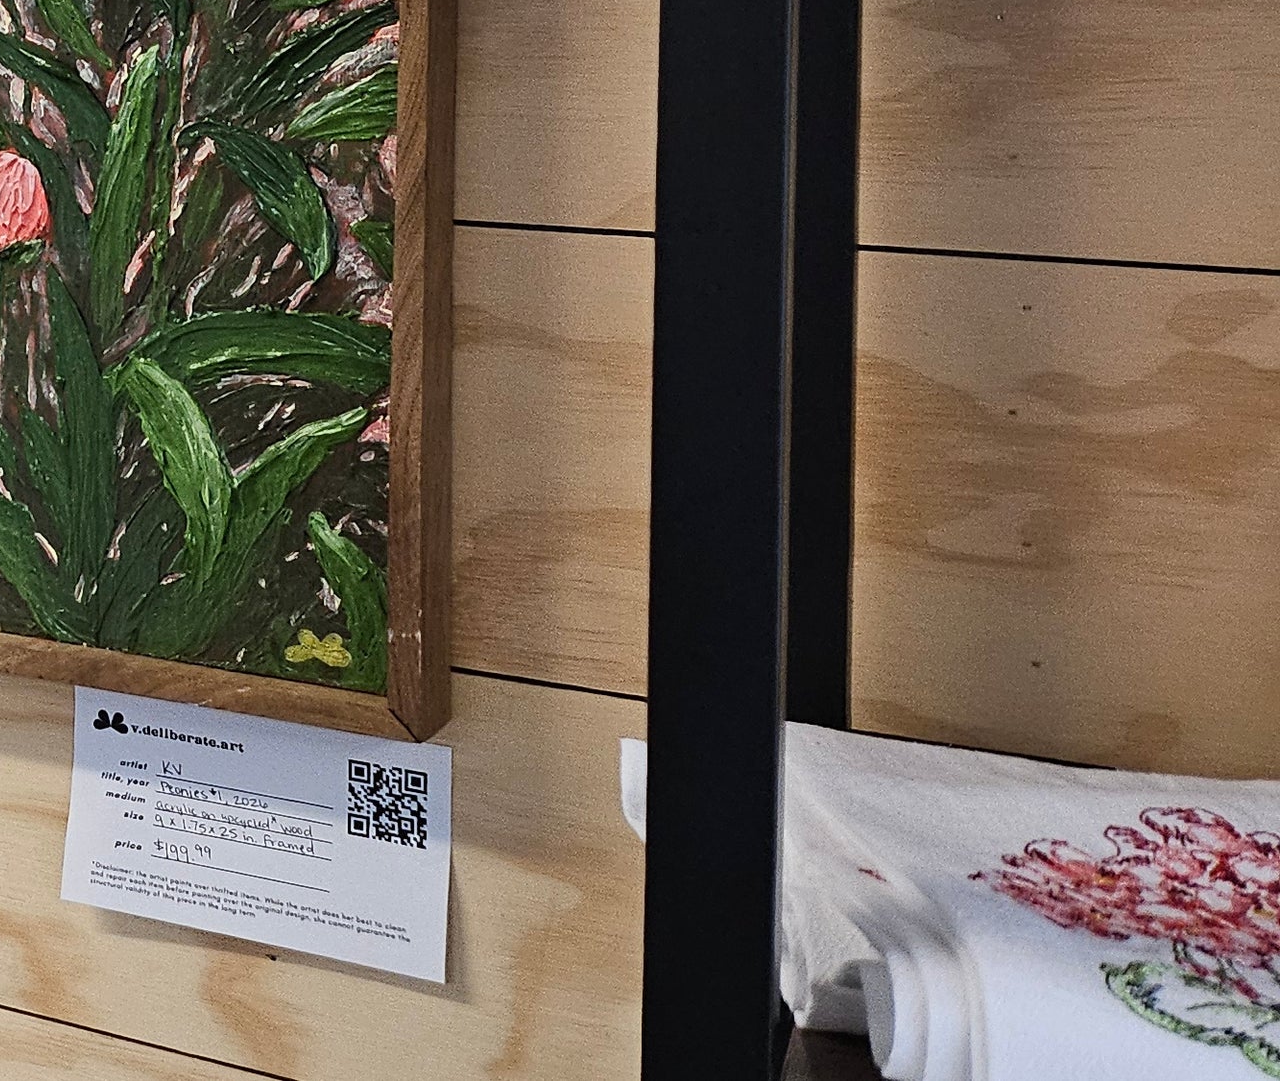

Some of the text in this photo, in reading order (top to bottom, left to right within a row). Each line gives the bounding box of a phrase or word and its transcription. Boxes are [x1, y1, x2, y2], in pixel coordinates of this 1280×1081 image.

[131, 724, 244, 753] v.deliberate.art
[120, 760, 182, 775] artist KV
[101, 771, 124, 783] title,
[127, 776, 150, 787] year
[160, 780, 208, 800] Peonies
[233, 796, 268, 808] 2026
[106, 790, 146, 804] medium
[155, 801, 197, 816] acrylic
[280, 824, 312, 837] wood
[124, 811, 144, 820] size
[155, 814, 164, 828] 9
[170, 818, 175, 826] x
[182, 820, 207, 834] 1.75
[209, 826, 215, 834] x
[220, 827, 238, 838] 25
[114, 838, 212, 864] price $199.99
[90, 879, 123, 890] structural
[125, 885, 150, 896] validity
[177, 897, 196, 905] piece
[208, 902, 218, 910] the
[221, 905, 237, 915] long
[106, 873, 127, 882] repair
[129, 878, 146, 886] each
[166, 884, 189, 895] before
[192, 891, 220, 903] painting
[314, 916, 325, 924] she
[328, 920, 354, 929] cannot
[398, 935, 410, 943] the
[194, 883, 210, 891] over
[322, 909, 339, 919] does
[341, 912, 354, 920] her
[356, 915, 372, 925] best
